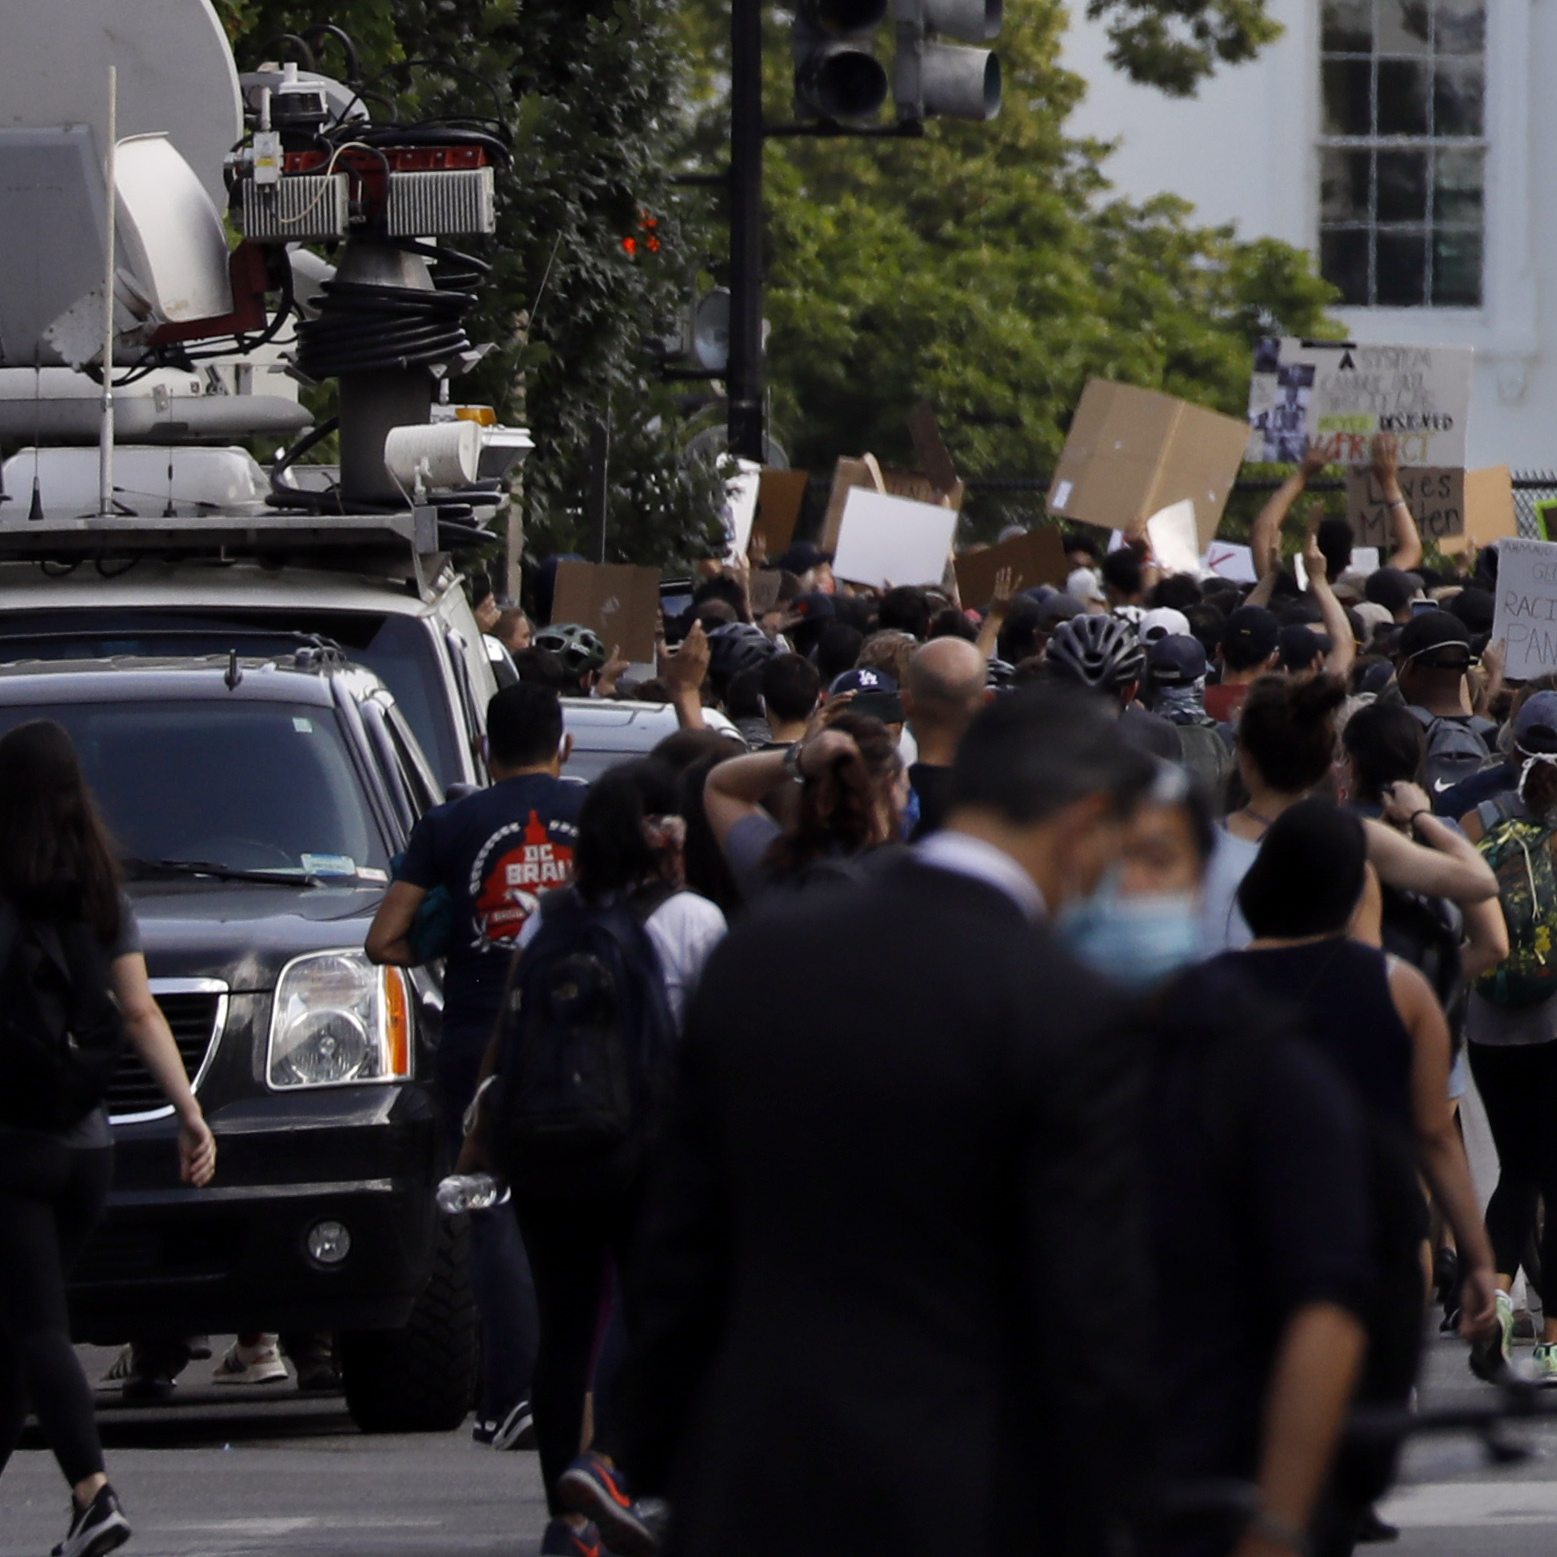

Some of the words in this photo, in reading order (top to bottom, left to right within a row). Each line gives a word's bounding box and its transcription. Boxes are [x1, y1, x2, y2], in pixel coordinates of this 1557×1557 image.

[1366, 474, 1451, 505] Lves
[1359, 501, 1459, 544] Mter
[523, 844, 554, 862] DC
